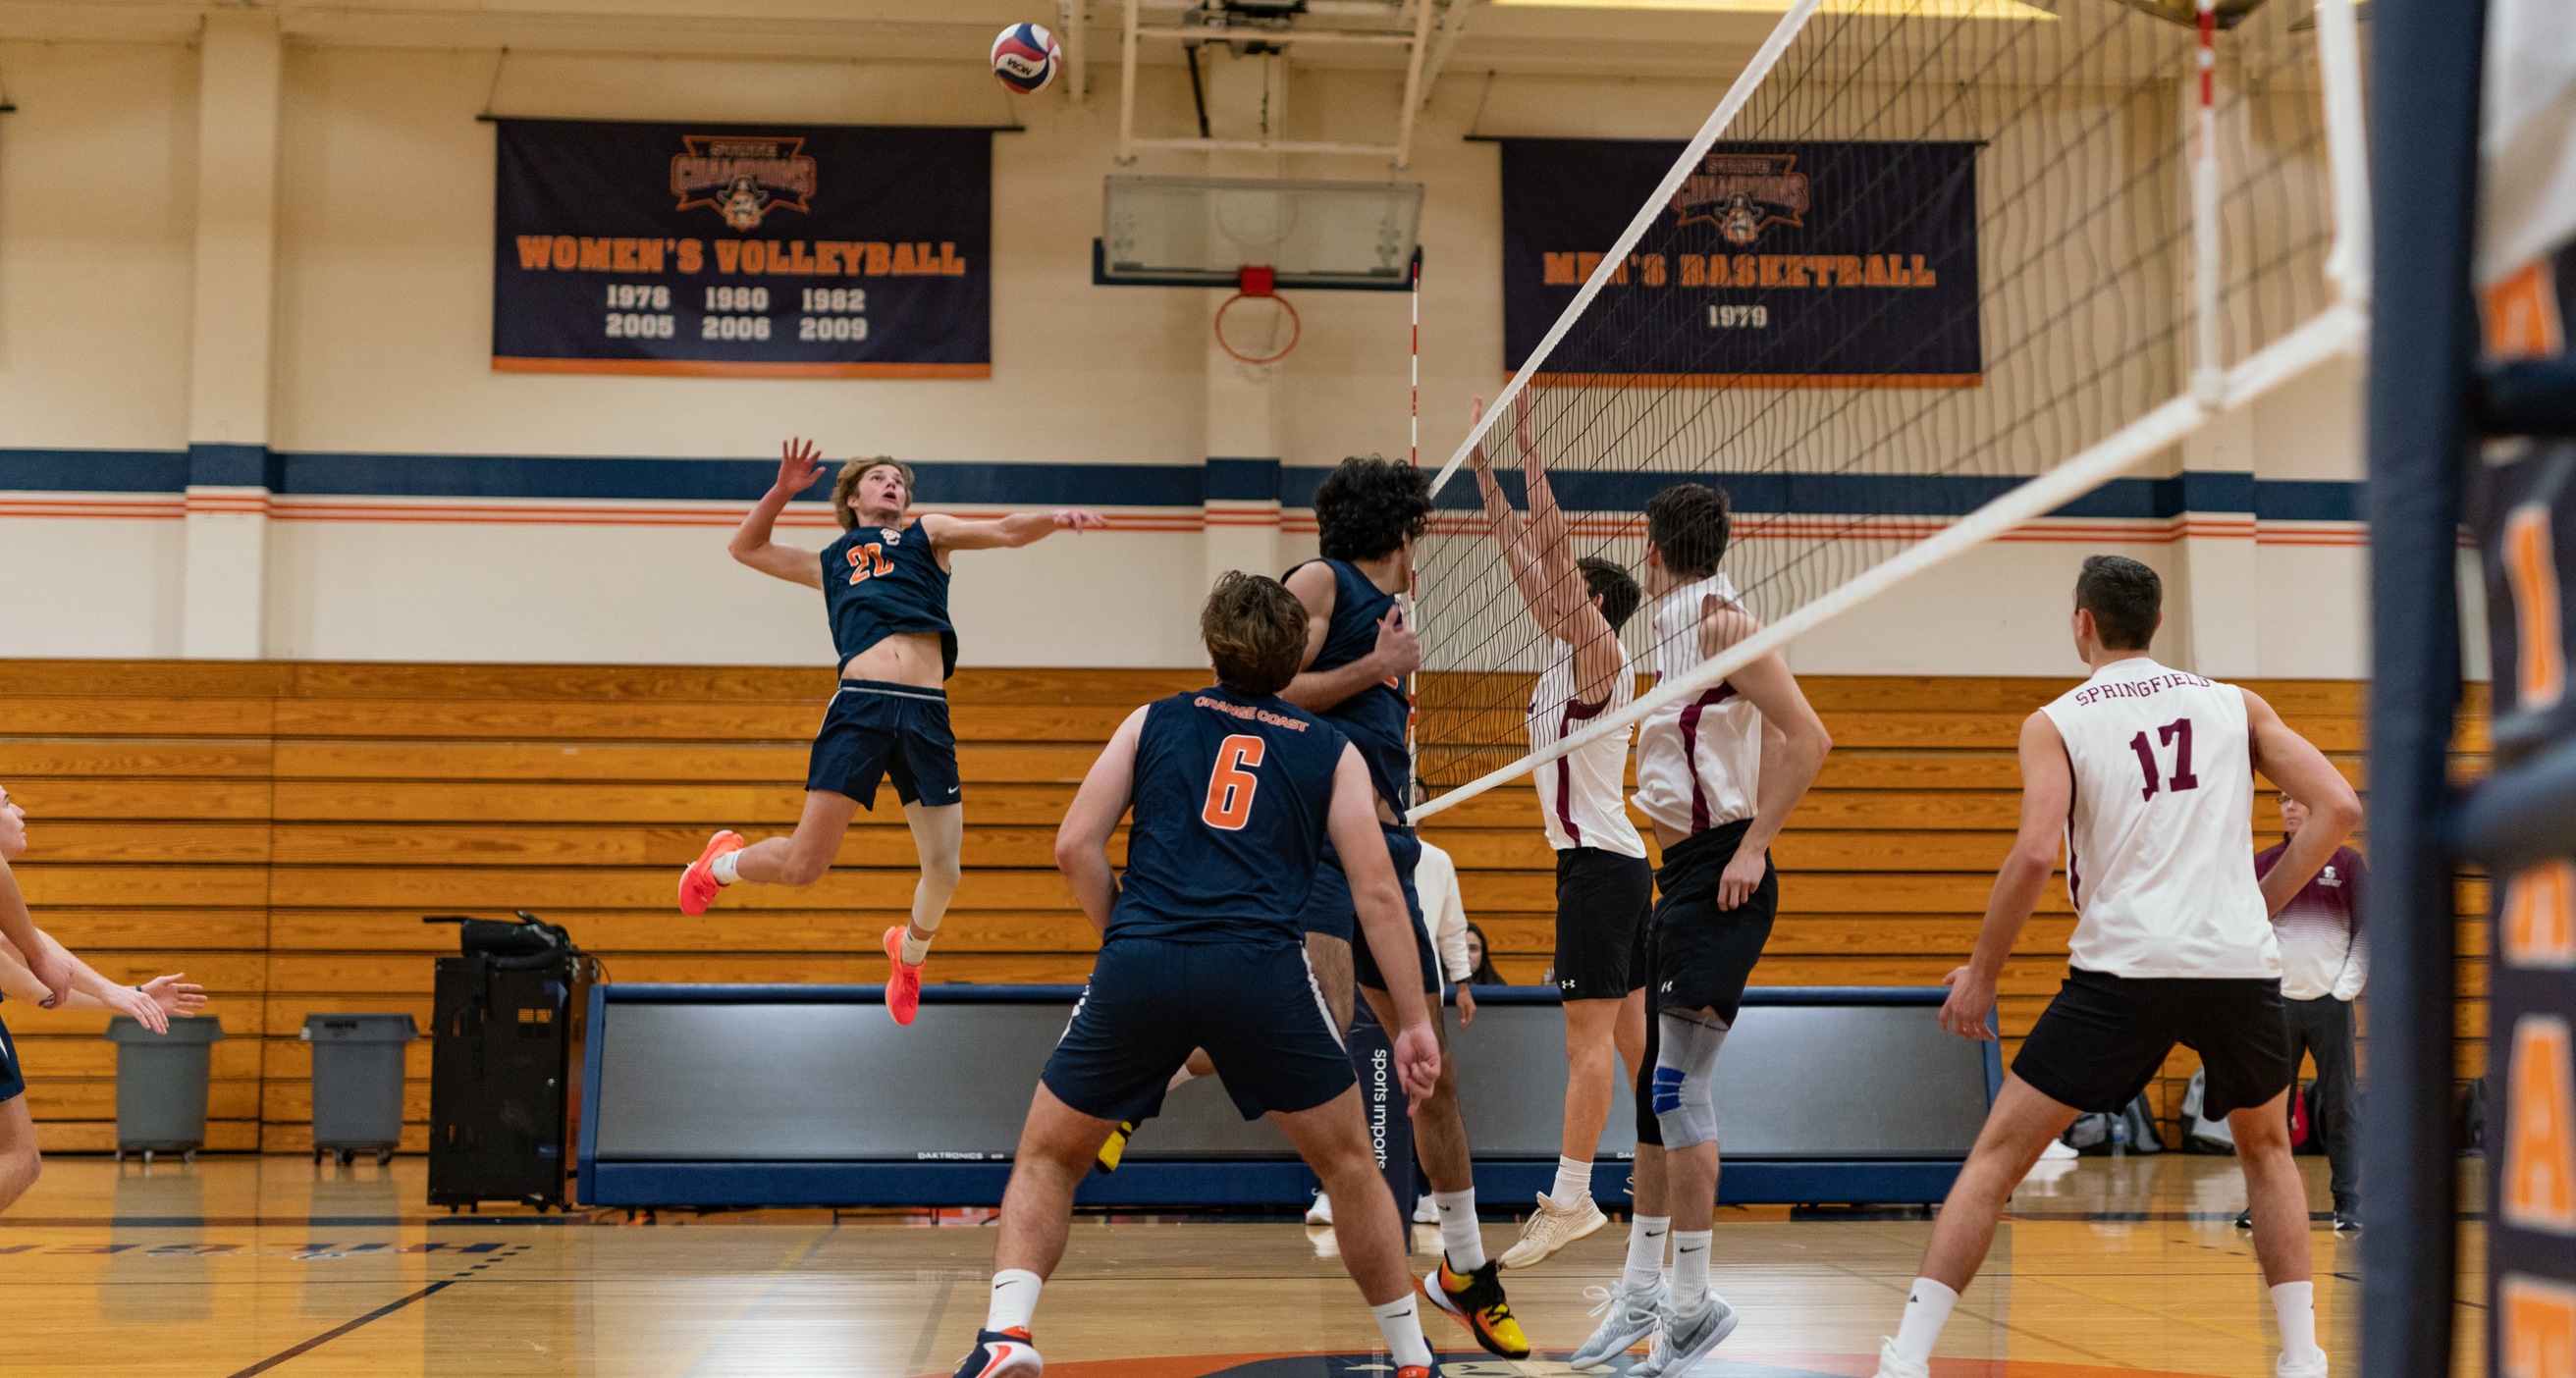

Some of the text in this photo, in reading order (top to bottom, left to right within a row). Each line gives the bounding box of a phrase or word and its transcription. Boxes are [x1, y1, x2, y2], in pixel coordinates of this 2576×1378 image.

[516, 235, 966, 276] WOMEN'S VOLLEYBALL
[1679, 253, 1937, 289] BASKETBALL
[606, 284, 867, 313] 1978 1980 1982
[1709, 304, 1768, 329] 1979
[605, 312, 869, 342] 2005 2006 2009
[846, 542, 894, 586] 22
[2075, 673, 2211, 706] SPRINGFIELD
[1194, 696, 1311, 732] ORANGE COAST
[2129, 717, 2199, 803] 17
[1202, 733, 1265, 831] 6
[1369, 1048, 1389, 1170] sports imports
[917, 1151, 984, 1160] DAKTRONICS
